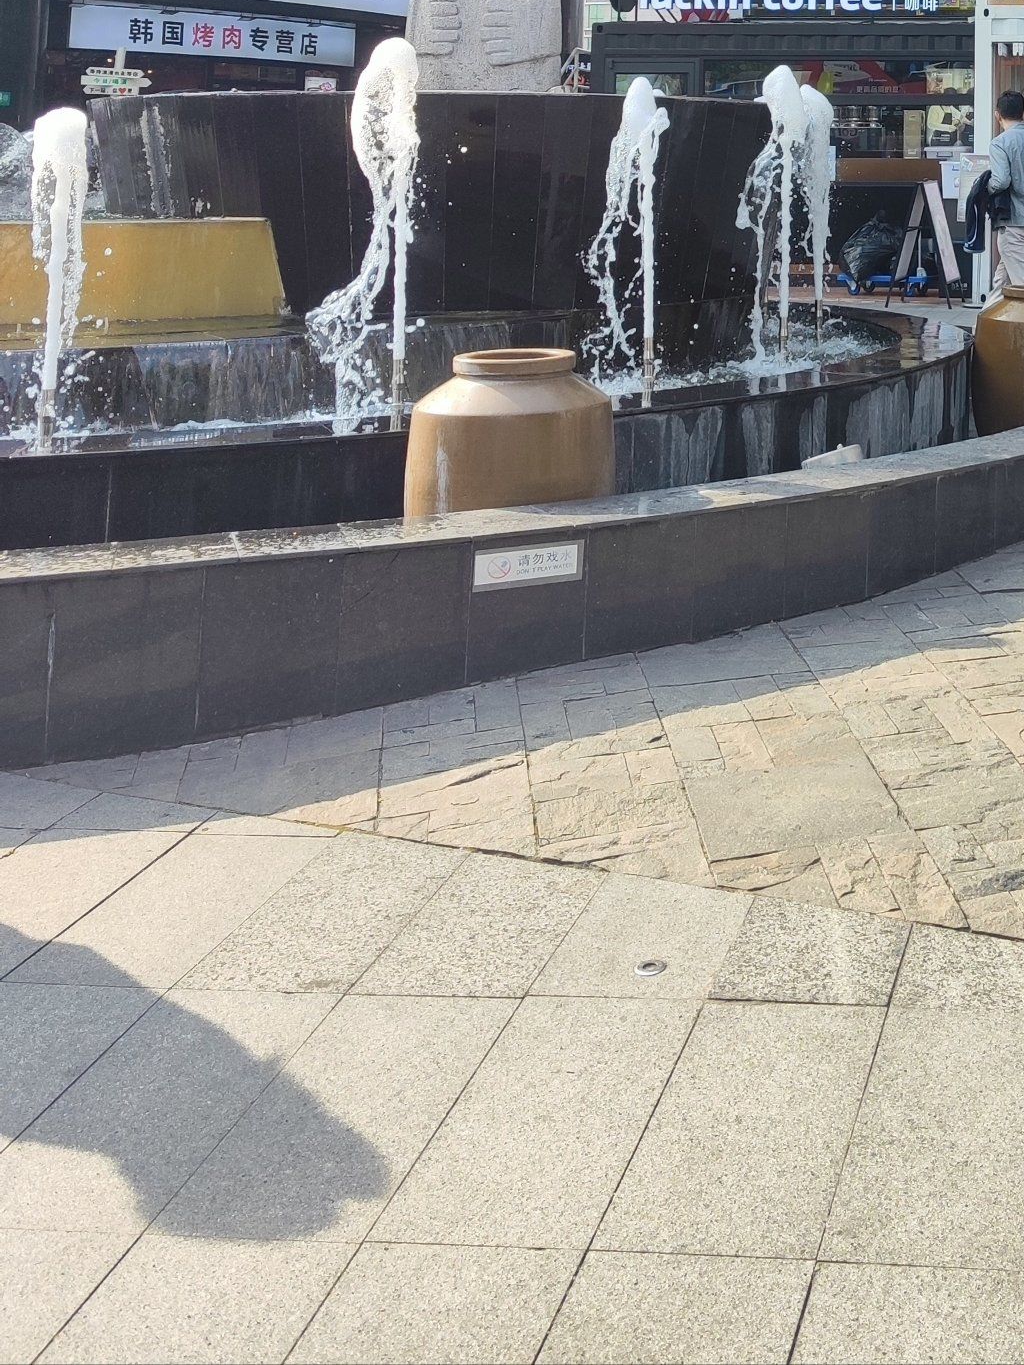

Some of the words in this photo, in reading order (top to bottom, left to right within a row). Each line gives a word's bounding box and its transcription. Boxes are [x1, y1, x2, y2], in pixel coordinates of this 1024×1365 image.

[128, 17, 319, 57] 韩国烤肉专营店
[517, 549, 572, 567] 请勿戏水
